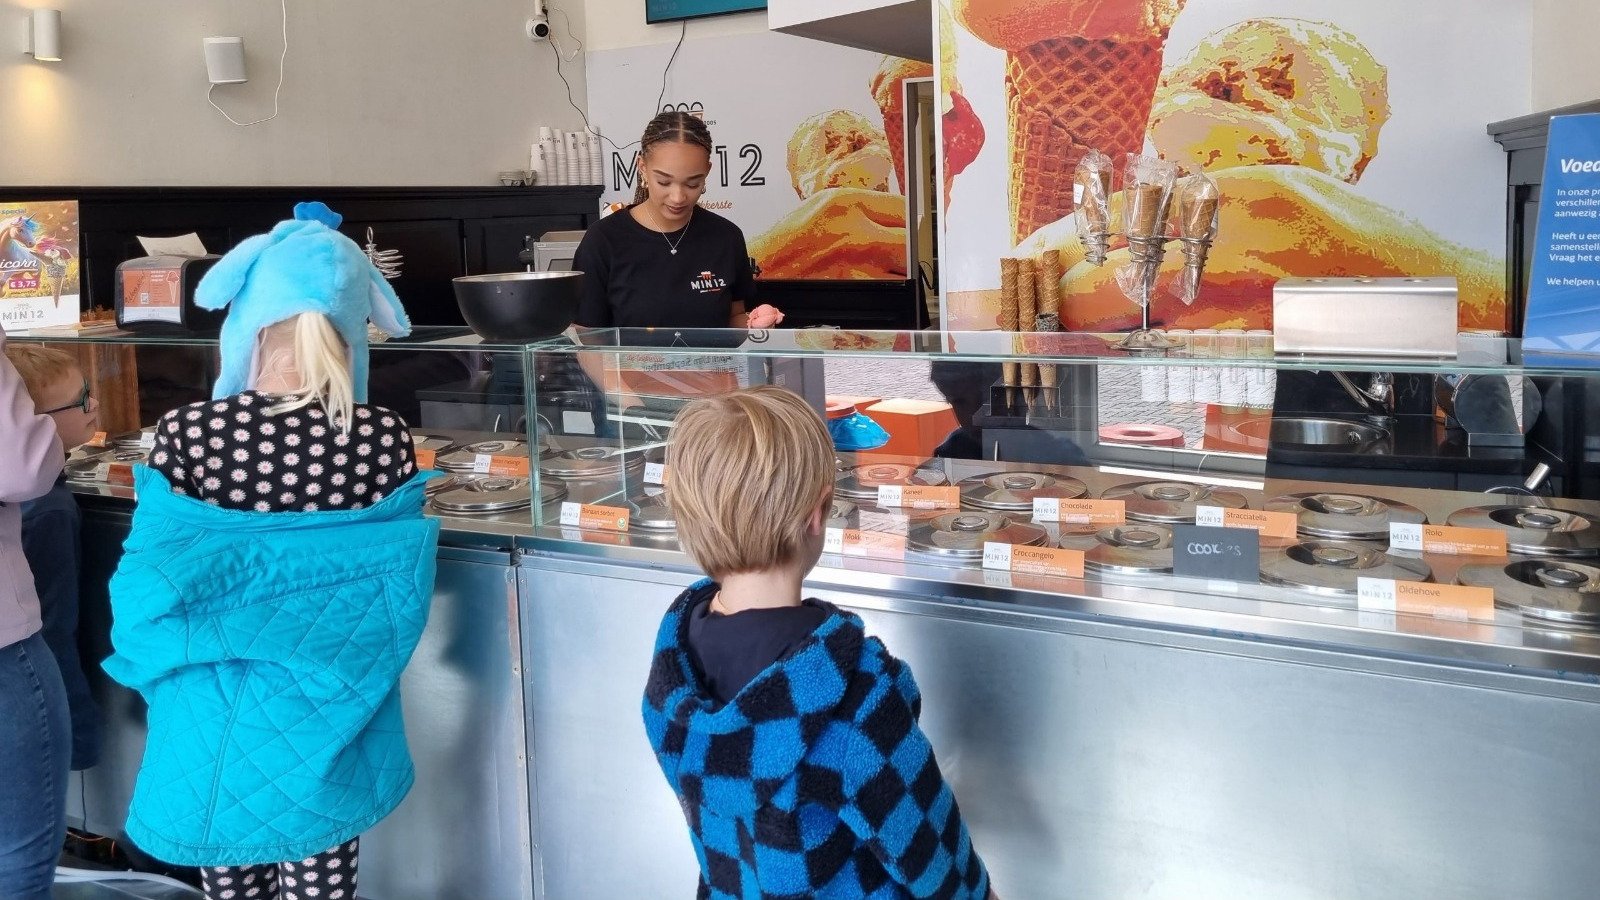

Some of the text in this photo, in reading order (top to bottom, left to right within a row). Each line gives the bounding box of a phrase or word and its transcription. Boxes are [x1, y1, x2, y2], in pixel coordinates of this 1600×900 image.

[1557, 188, 1566, 196] In
[1554, 210, 1597, 219] aanwezig
[1552, 231, 1577, 240] Heeft
[1549, 253, 1576, 263] Vraag
[1577, 254, 1593, 262] het
[17, 280, 37, 288] 3,75
[1546, 277, 1562, 286] We
[1562, 277, 1595, 287] helpen
[903, 488, 923, 496] Kaneel
[1060, 502, 1093, 510] Chocolade
[1225, 511, 1268, 522] Stracciatella
[1425, 528, 1444, 537] Rolo
[1013, 548, 1055, 560] Croccangelo
[1399, 585, 1441, 597] Oldehove
